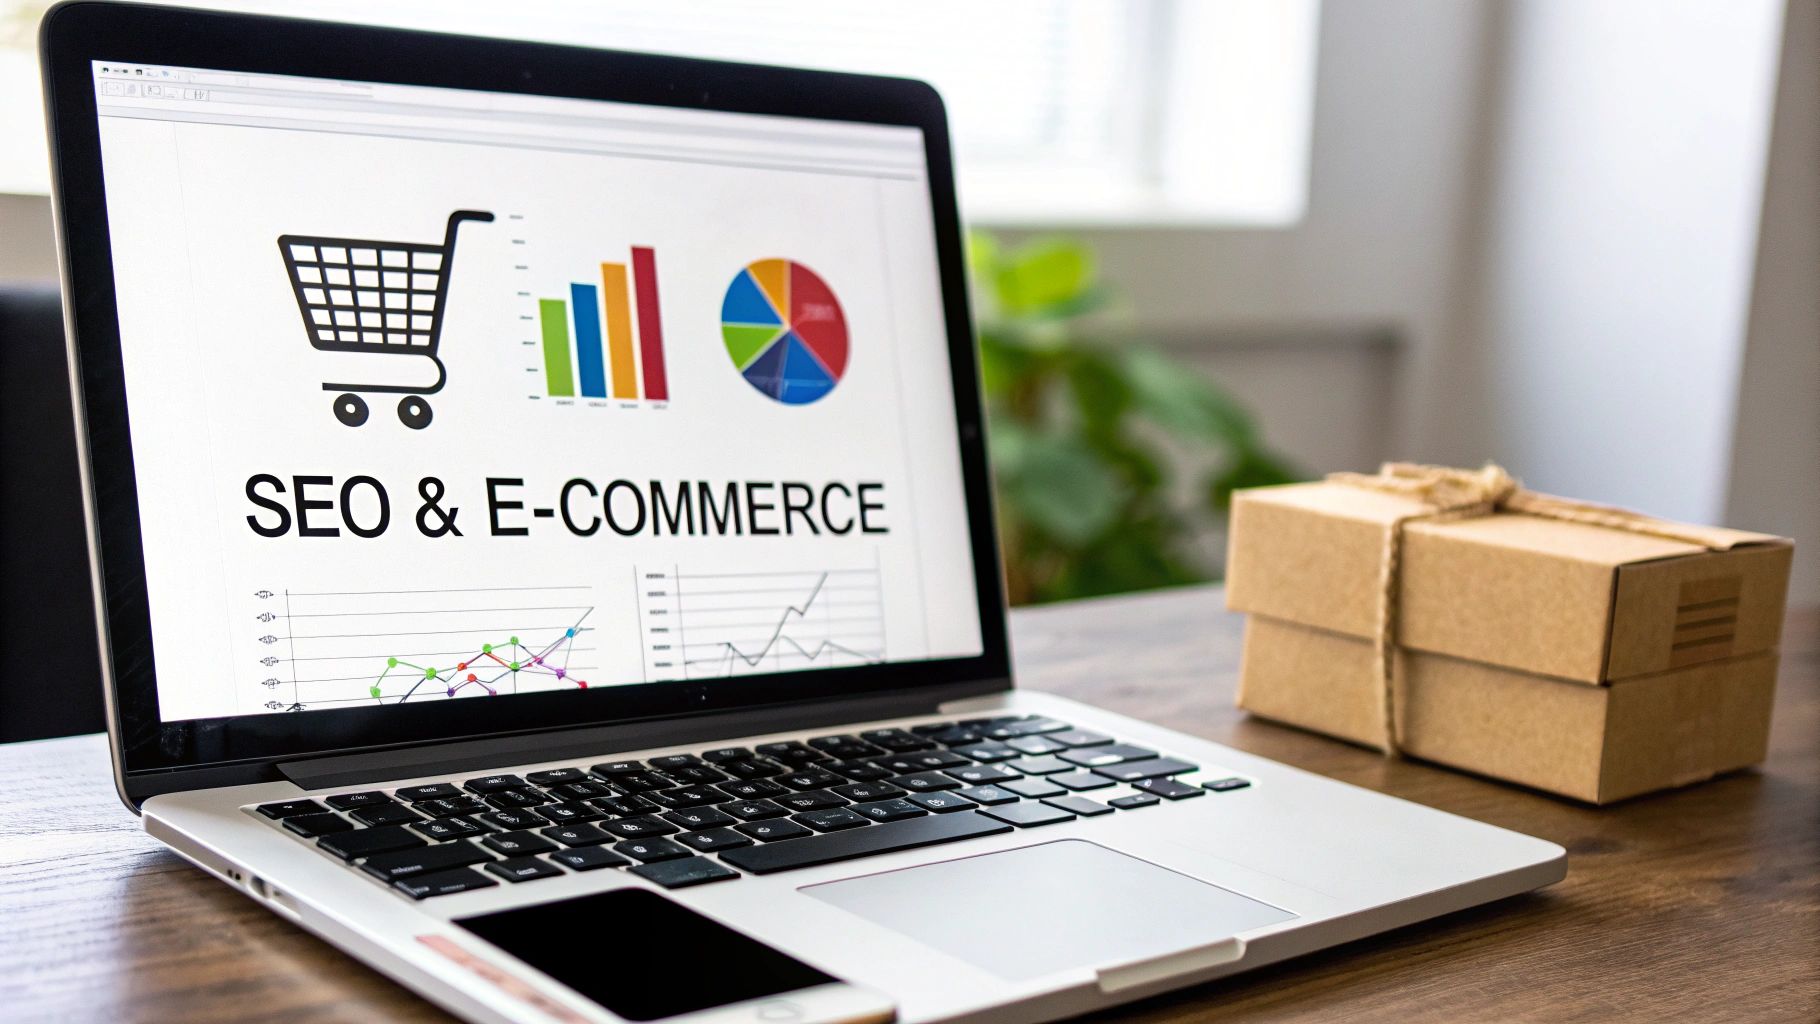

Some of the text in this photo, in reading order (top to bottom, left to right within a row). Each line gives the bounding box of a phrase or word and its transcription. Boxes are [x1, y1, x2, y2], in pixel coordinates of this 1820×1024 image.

[245, 473, 890, 539] SEO & E-COMMERCE
